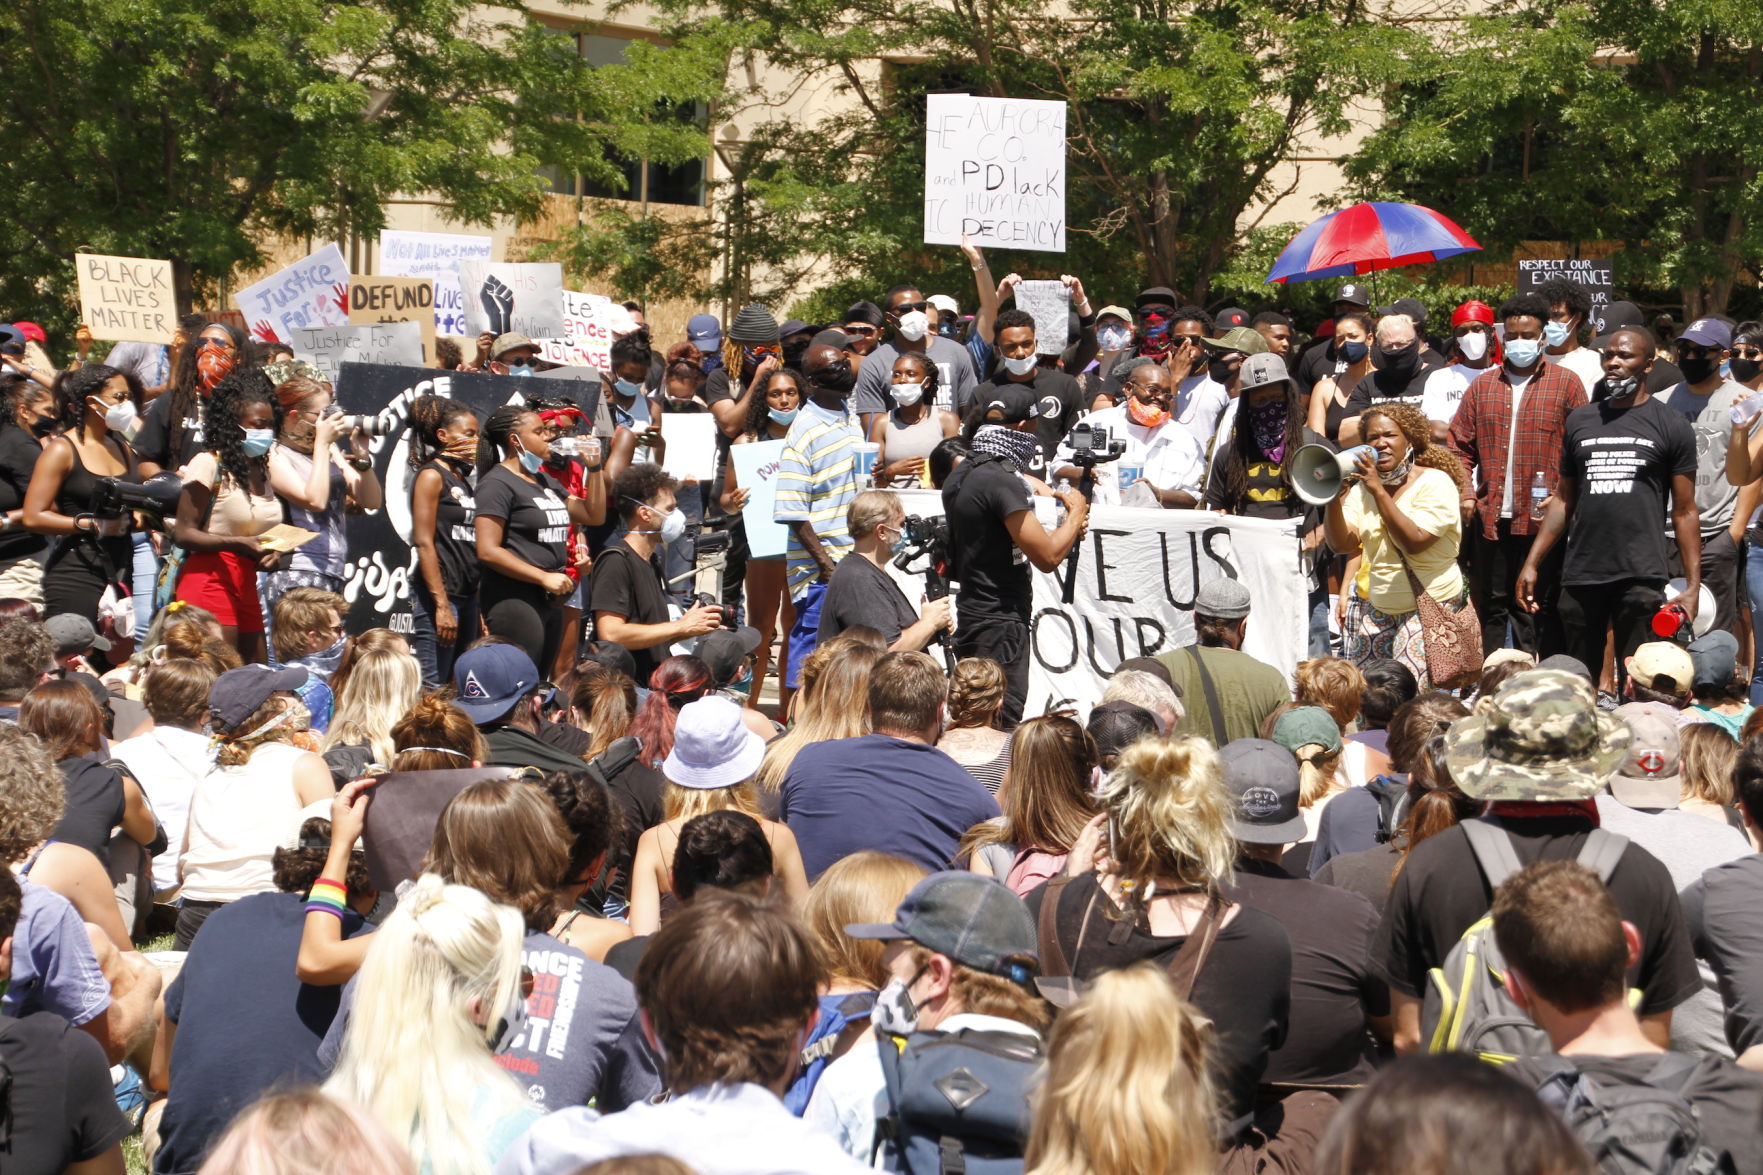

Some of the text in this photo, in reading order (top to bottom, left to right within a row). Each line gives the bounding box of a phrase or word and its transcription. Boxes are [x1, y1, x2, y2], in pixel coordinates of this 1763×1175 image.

[962, 218, 1062, 248] DECENCY
[88, 259, 168, 289] BLACK
[1519, 260, 1592, 270] RESPECT OUR
[1532, 270, 1612, 285] EXISTANCE
[101, 285, 160, 308] LIVES
[256, 264, 336, 314] Justice
[351, 283, 433, 311] DEFUND
[433, 282, 463, 310] Live
[560, 292, 595, 319] ite
[91, 306, 170, 334] MATTER
[302, 325, 395, 350] Justice For
[1589, 480, 1633, 495] NOW
[1157, 526, 1239, 611] US
[1031, 607, 1166, 680] OUR
[1246, 792, 1277, 802] LOVE
